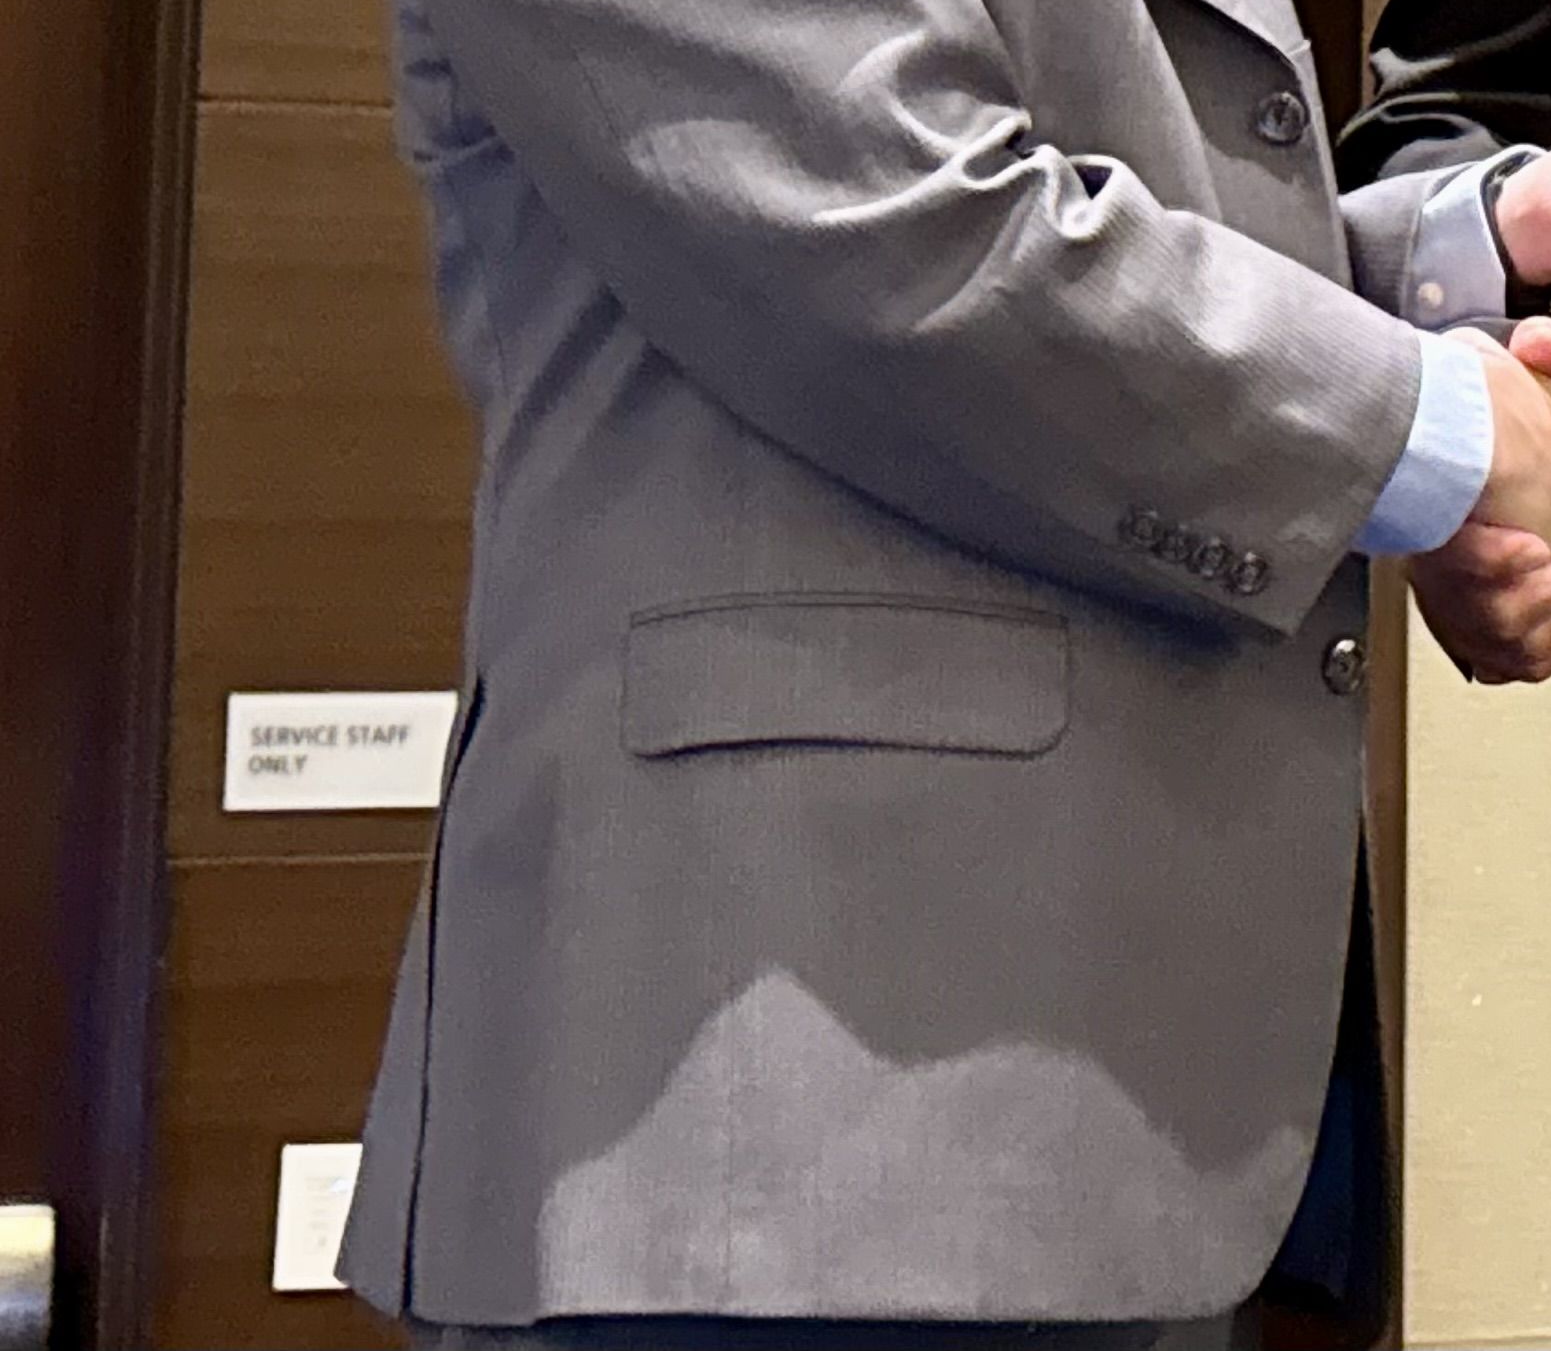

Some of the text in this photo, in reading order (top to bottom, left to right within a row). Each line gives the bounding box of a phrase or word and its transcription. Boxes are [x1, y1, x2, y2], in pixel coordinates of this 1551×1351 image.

[251, 724, 409, 747] SERVICE STAFF
[248, 755, 308, 775] ONLY
